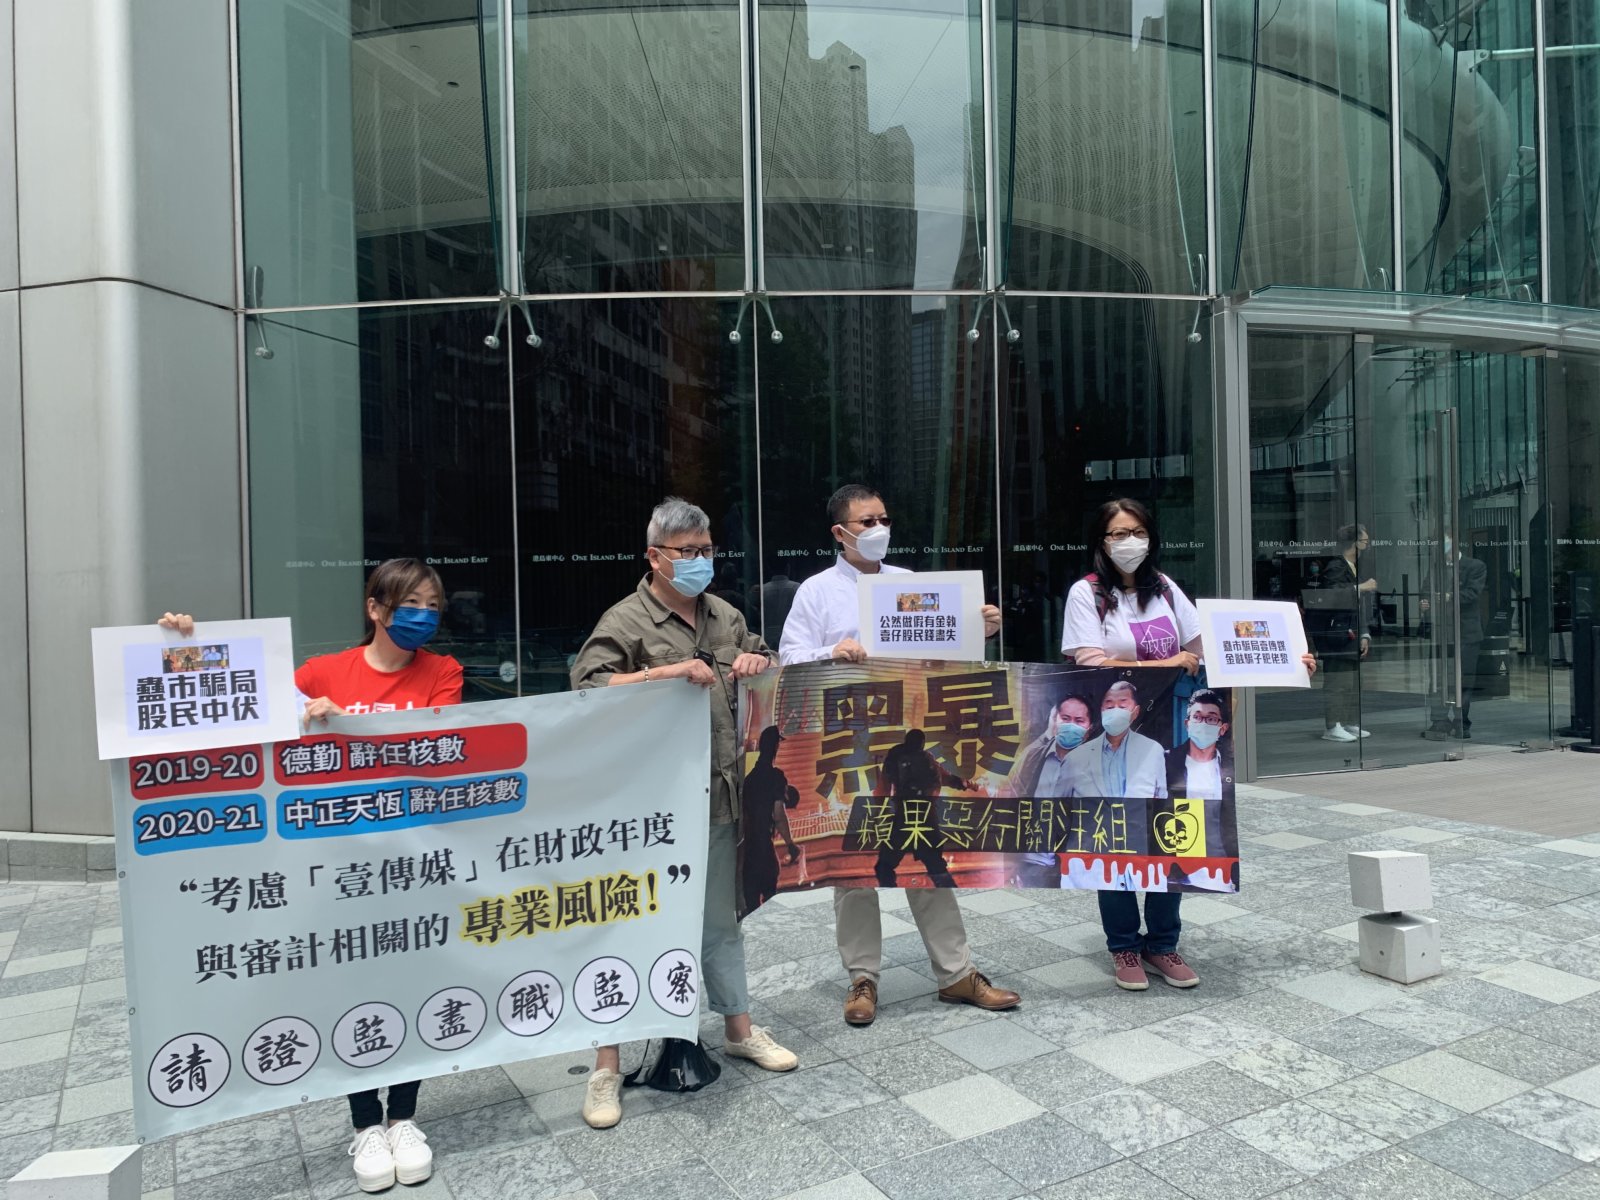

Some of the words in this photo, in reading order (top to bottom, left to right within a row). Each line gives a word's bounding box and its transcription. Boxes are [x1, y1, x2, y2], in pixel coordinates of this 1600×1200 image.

[816, 548, 832, 556] ONE
[941, 545, 965, 553] ISLAND
[1050, 543, 1065, 551] ONE
[1066, 543, 1087, 551] ISLAN
[322, 559, 336, 567] ONE
[338, 559, 362, 567] ISLAND
[426, 557, 442, 565] ONE
[444, 556, 469, 564] ISLAND
[590, 553, 615, 561] ISLAND
[880, 615, 956, 628] 公然做假有金執
[880, 629, 956, 642] 壹仔股民錢盡失
[136, 669, 258, 703] 蠱市騙局
[138, 696, 260, 731] 股民中伏
[816, 670, 1021, 799] 黑暴
[134, 752, 260, 787] 2019-20
[281, 744, 341, 775] 德勤
[349, 735, 466, 768] 辭任核數
[138, 804, 262, 841] 2020-21
[284, 792, 403, 829] 中正天恆
[409, 778, 522, 813] 辭任核數
[857, 798, 1138, 853] 蘋果惡行關注組
